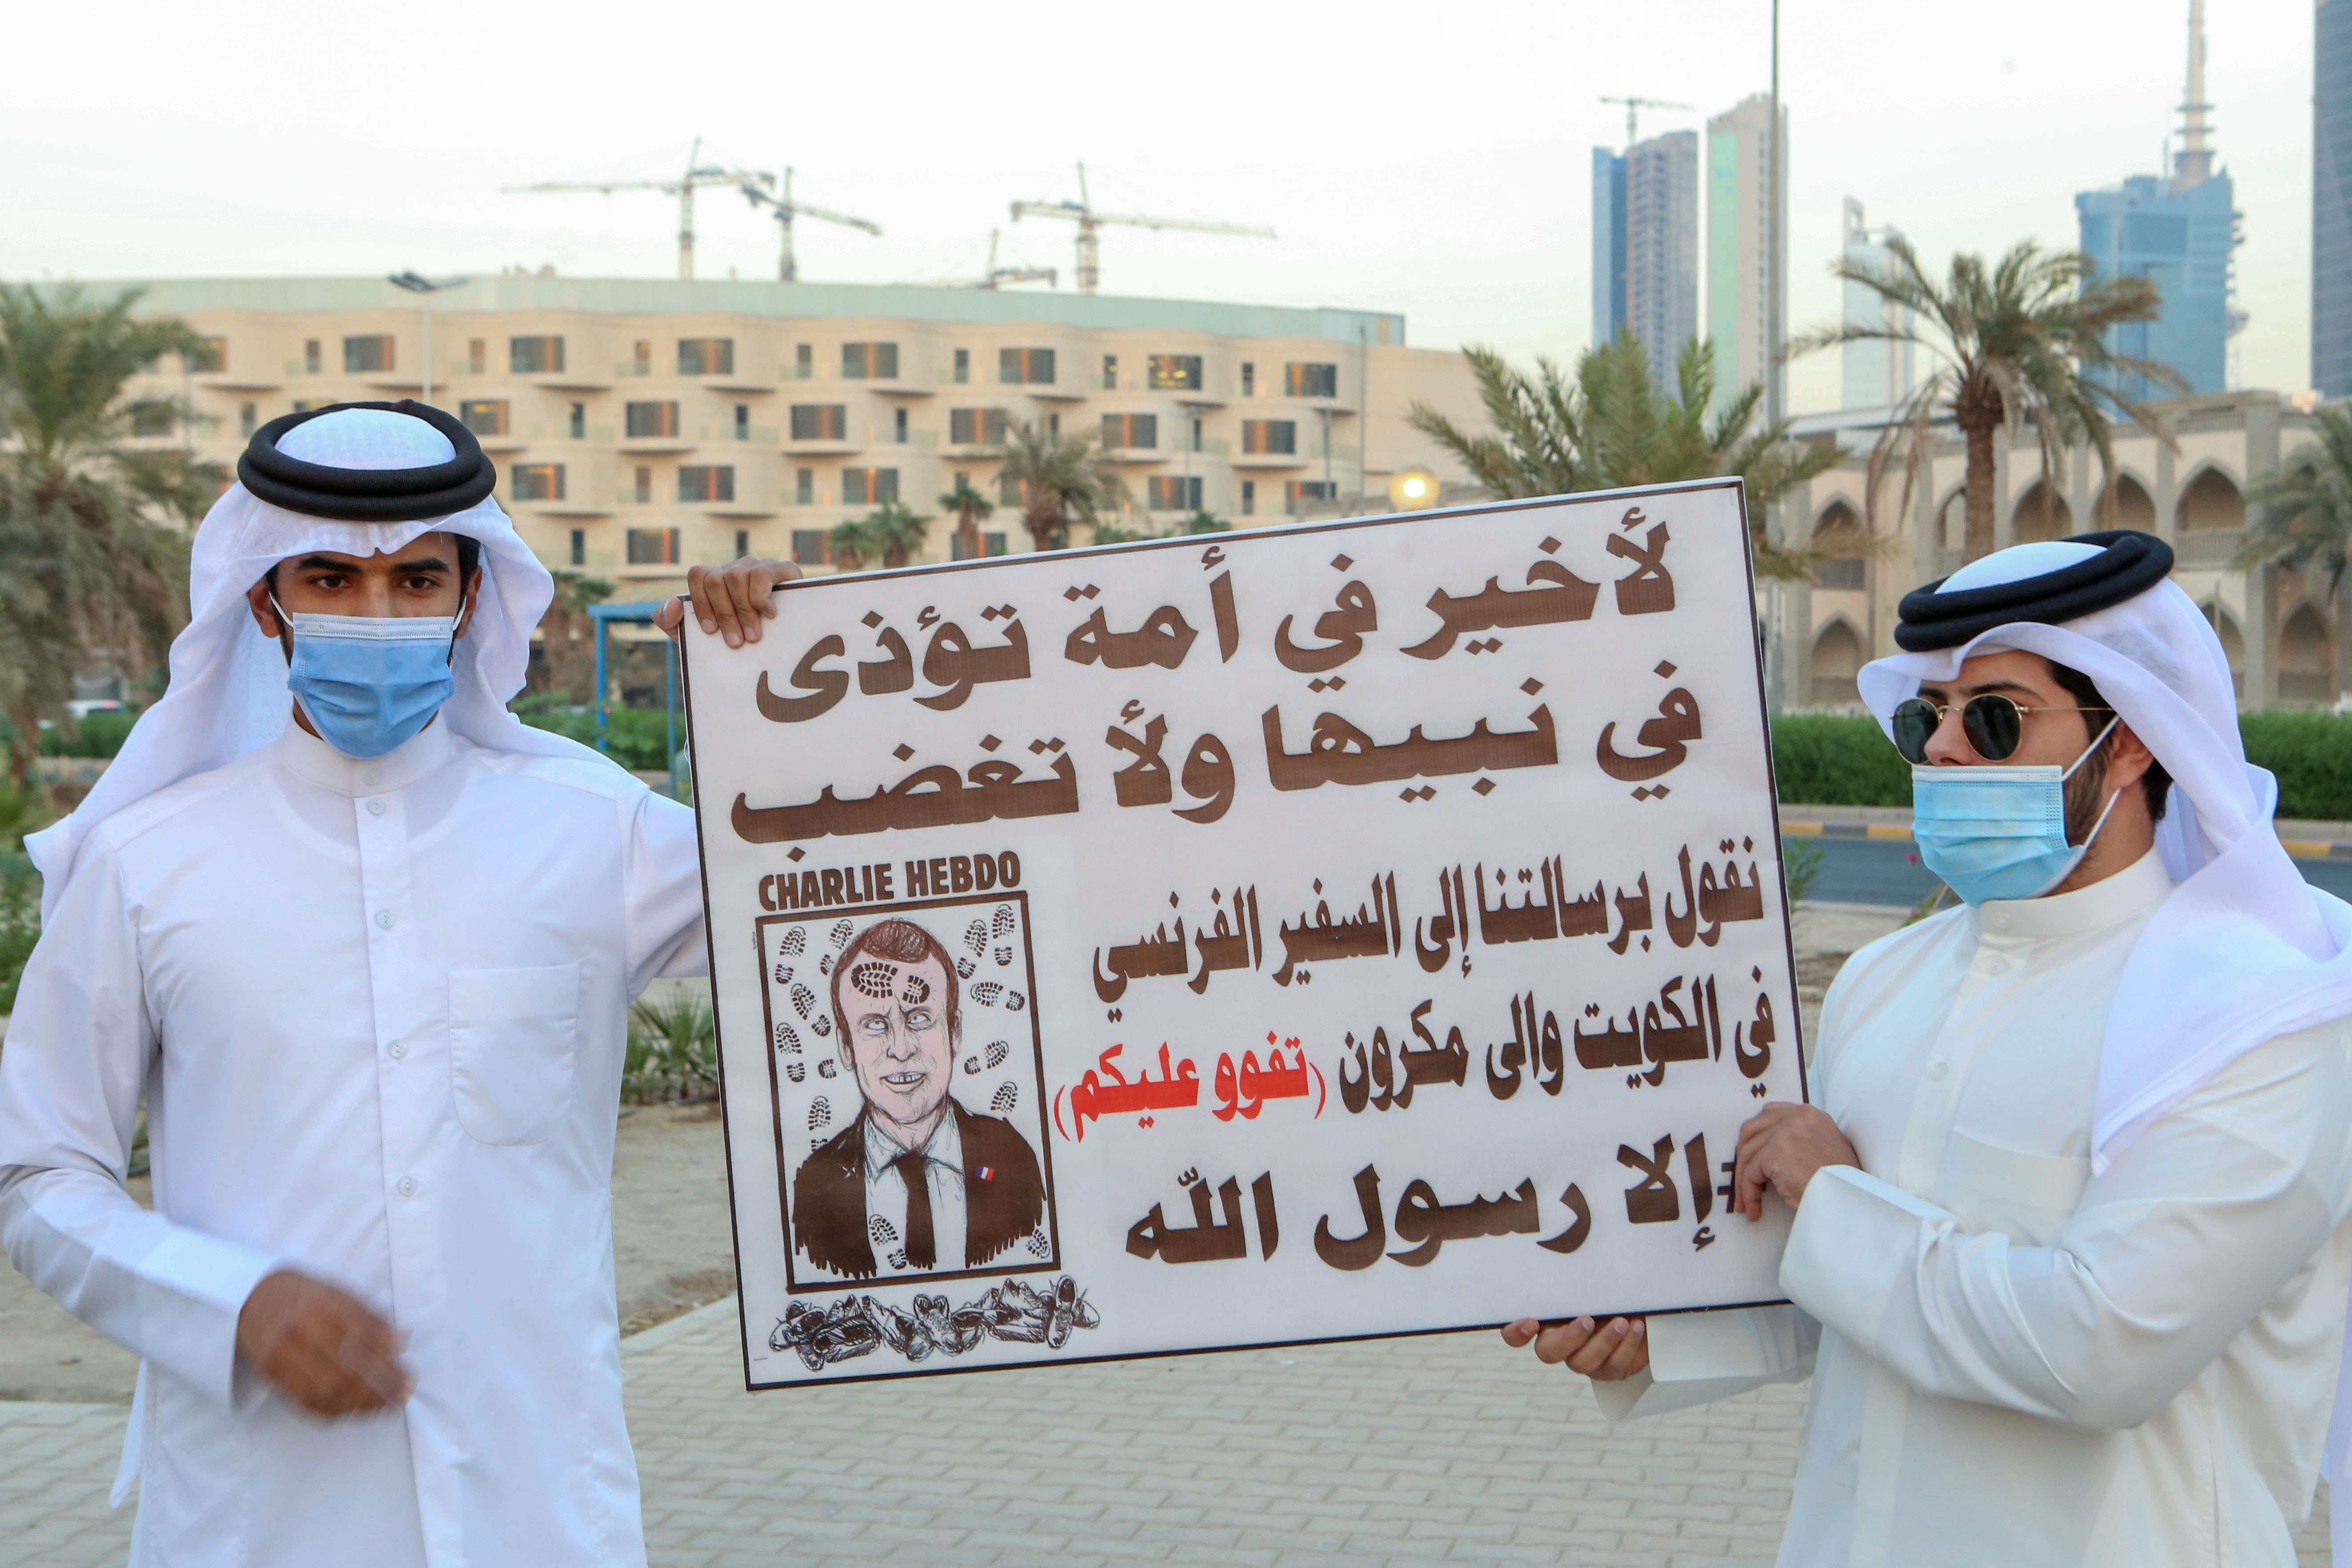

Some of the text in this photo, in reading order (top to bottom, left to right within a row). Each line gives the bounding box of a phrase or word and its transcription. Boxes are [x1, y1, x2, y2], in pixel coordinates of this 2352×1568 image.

[756, 603, 1032, 723] تؤذى
[1063, 545, 1240, 670] أمة
[1274, 553, 1378, 694] في
[1261, 677, 1560, 804] نبيها
[1596, 659, 1703, 802] في
[730, 733, 1080, 863] تغضب
[758, 850, 1021, 912] CHARLIE HEBDO
[1092, 835, 1764, 1024] نقول برسالتنا إلى السفير الفرنسي
[1338, 998, 1470, 1115] مكرون
[1573, 973, 1722, 1090] الكويت
[1734, 965, 1776, 1099] في
[1313, 1162, 1592, 1272] رسول
